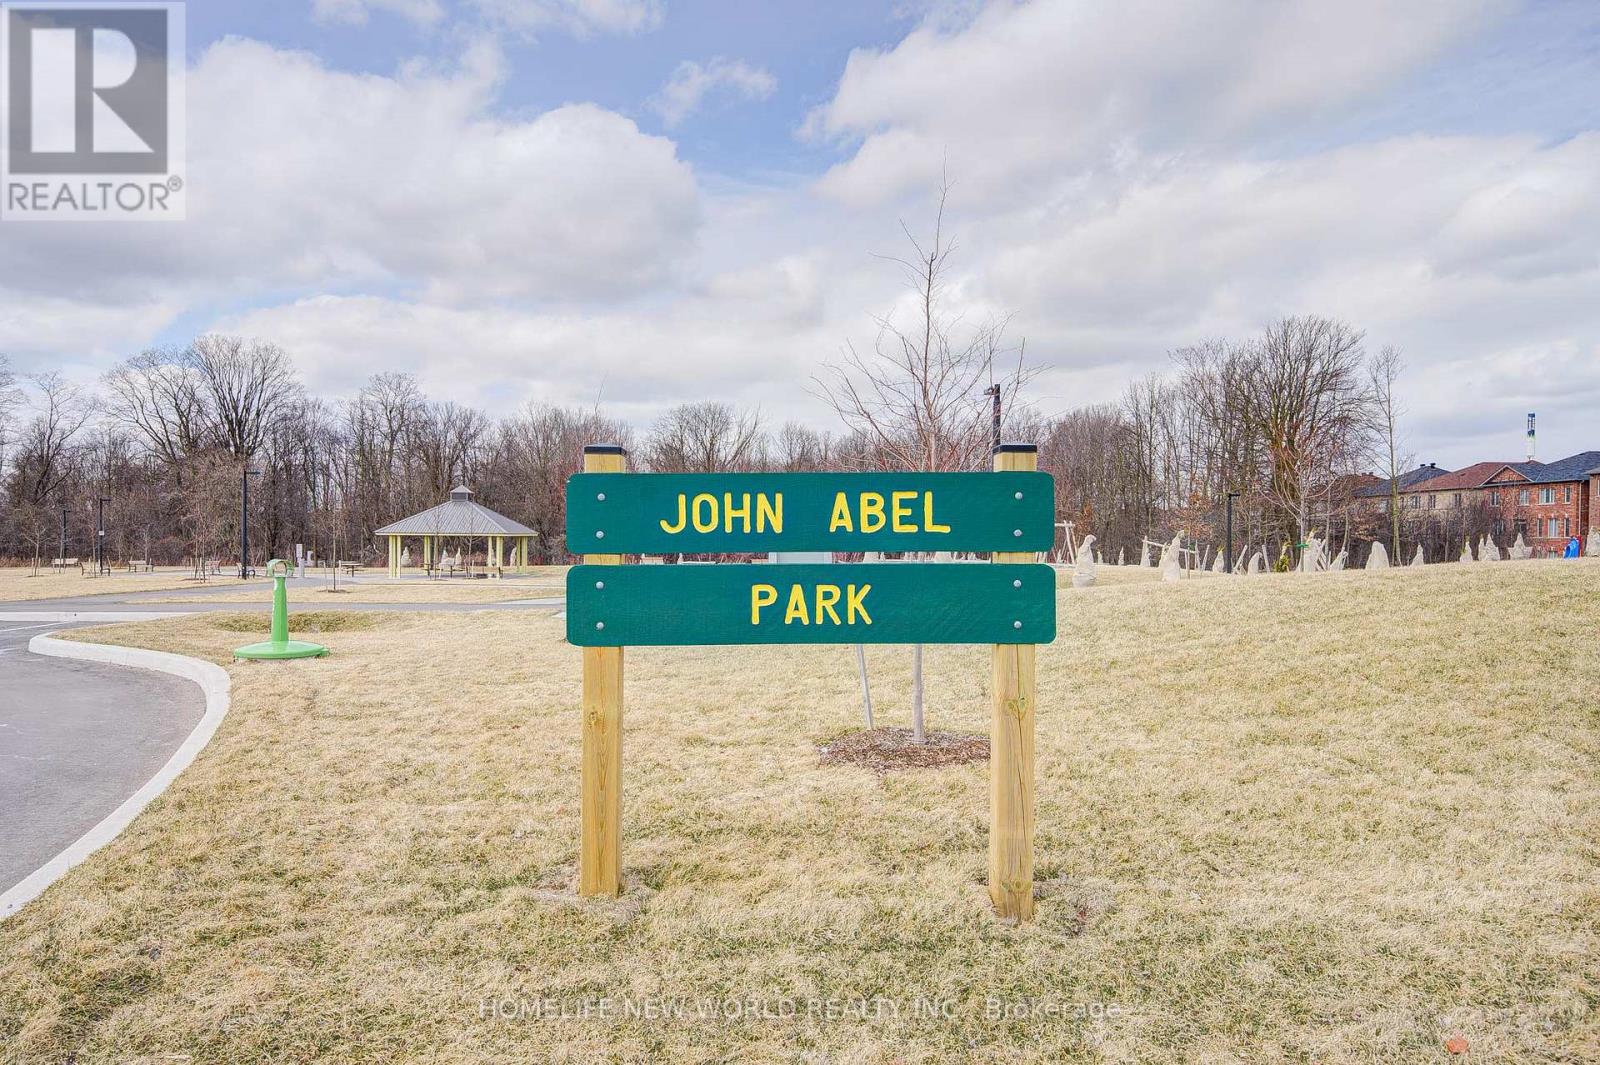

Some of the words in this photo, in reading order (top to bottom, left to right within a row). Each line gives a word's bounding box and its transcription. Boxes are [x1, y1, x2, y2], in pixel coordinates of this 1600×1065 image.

[659, 492, 783, 534] JOHN
[829, 491, 951, 534] ABEL
[751, 584, 872, 626] PARK
